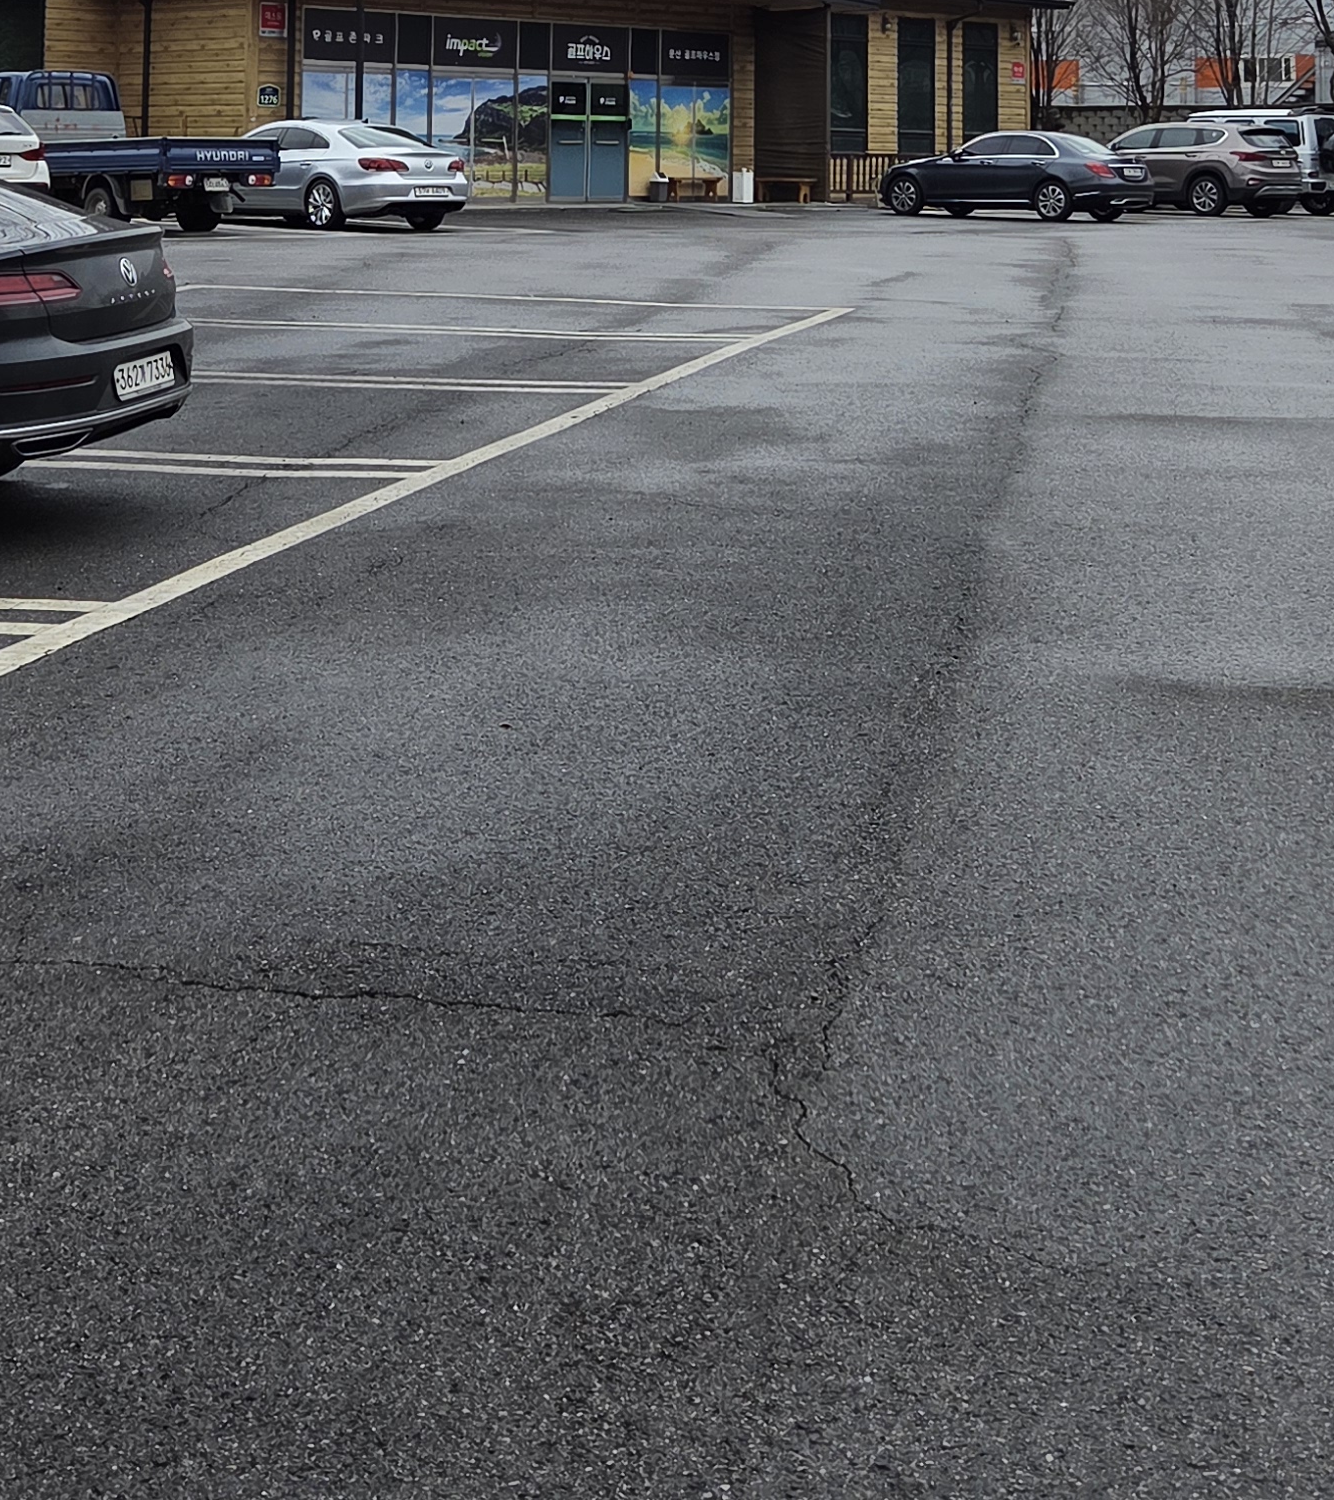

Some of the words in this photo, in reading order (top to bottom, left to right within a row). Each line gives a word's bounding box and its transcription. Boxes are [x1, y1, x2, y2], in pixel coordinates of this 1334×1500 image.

[445, 33, 492, 57] impact
[567, 43, 611, 60] 골프하우스
[260, 94, 278, 105] 1276
[196, 150, 250, 161] HYUNDAI
